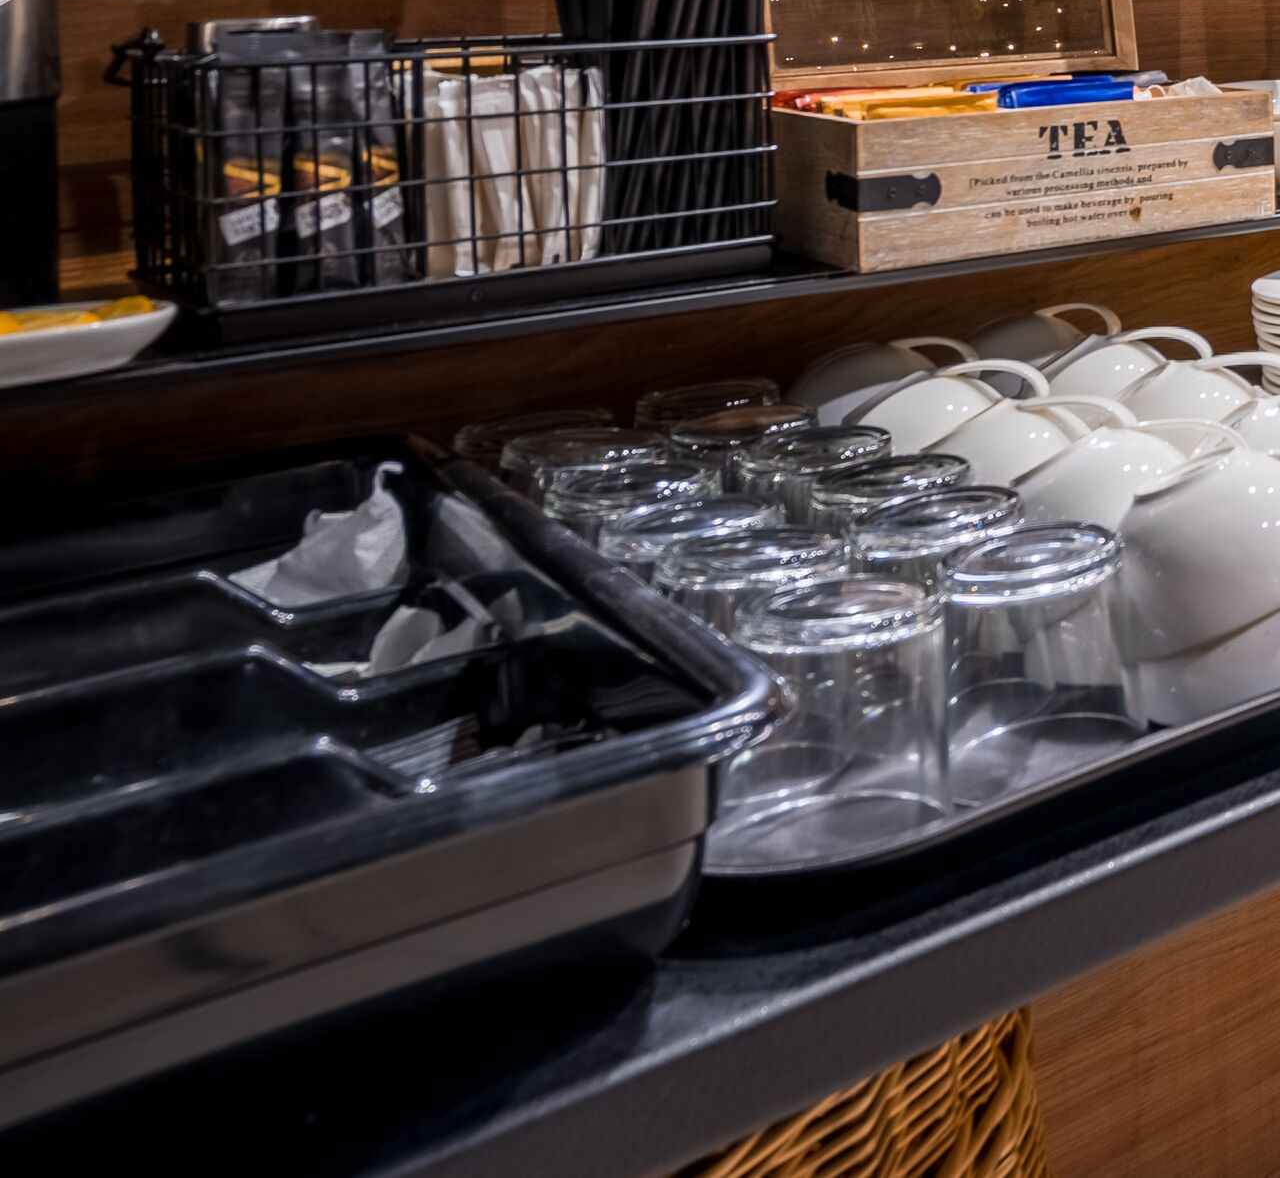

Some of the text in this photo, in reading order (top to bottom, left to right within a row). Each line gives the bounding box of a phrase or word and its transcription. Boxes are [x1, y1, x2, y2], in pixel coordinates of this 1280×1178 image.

[1038, 119, 1131, 160] TEA
[1009, 174, 1033, 183] from
[1035, 171, 1050, 180] the
[1052, 167, 1095, 179] Camellia
[1138, 160, 1176, 173] prepared
[1178, 158, 1189, 168] by
[1006, 174, 1152, 196] various processing methods and
[984, 192, 1173, 220] can be used to make beverage by pouring
[1027, 216, 1061, 228] boiling
[1063, 214, 1078, 223] hot
[1080, 212, 1105, 221] water
[1107, 209, 1128, 218] over
